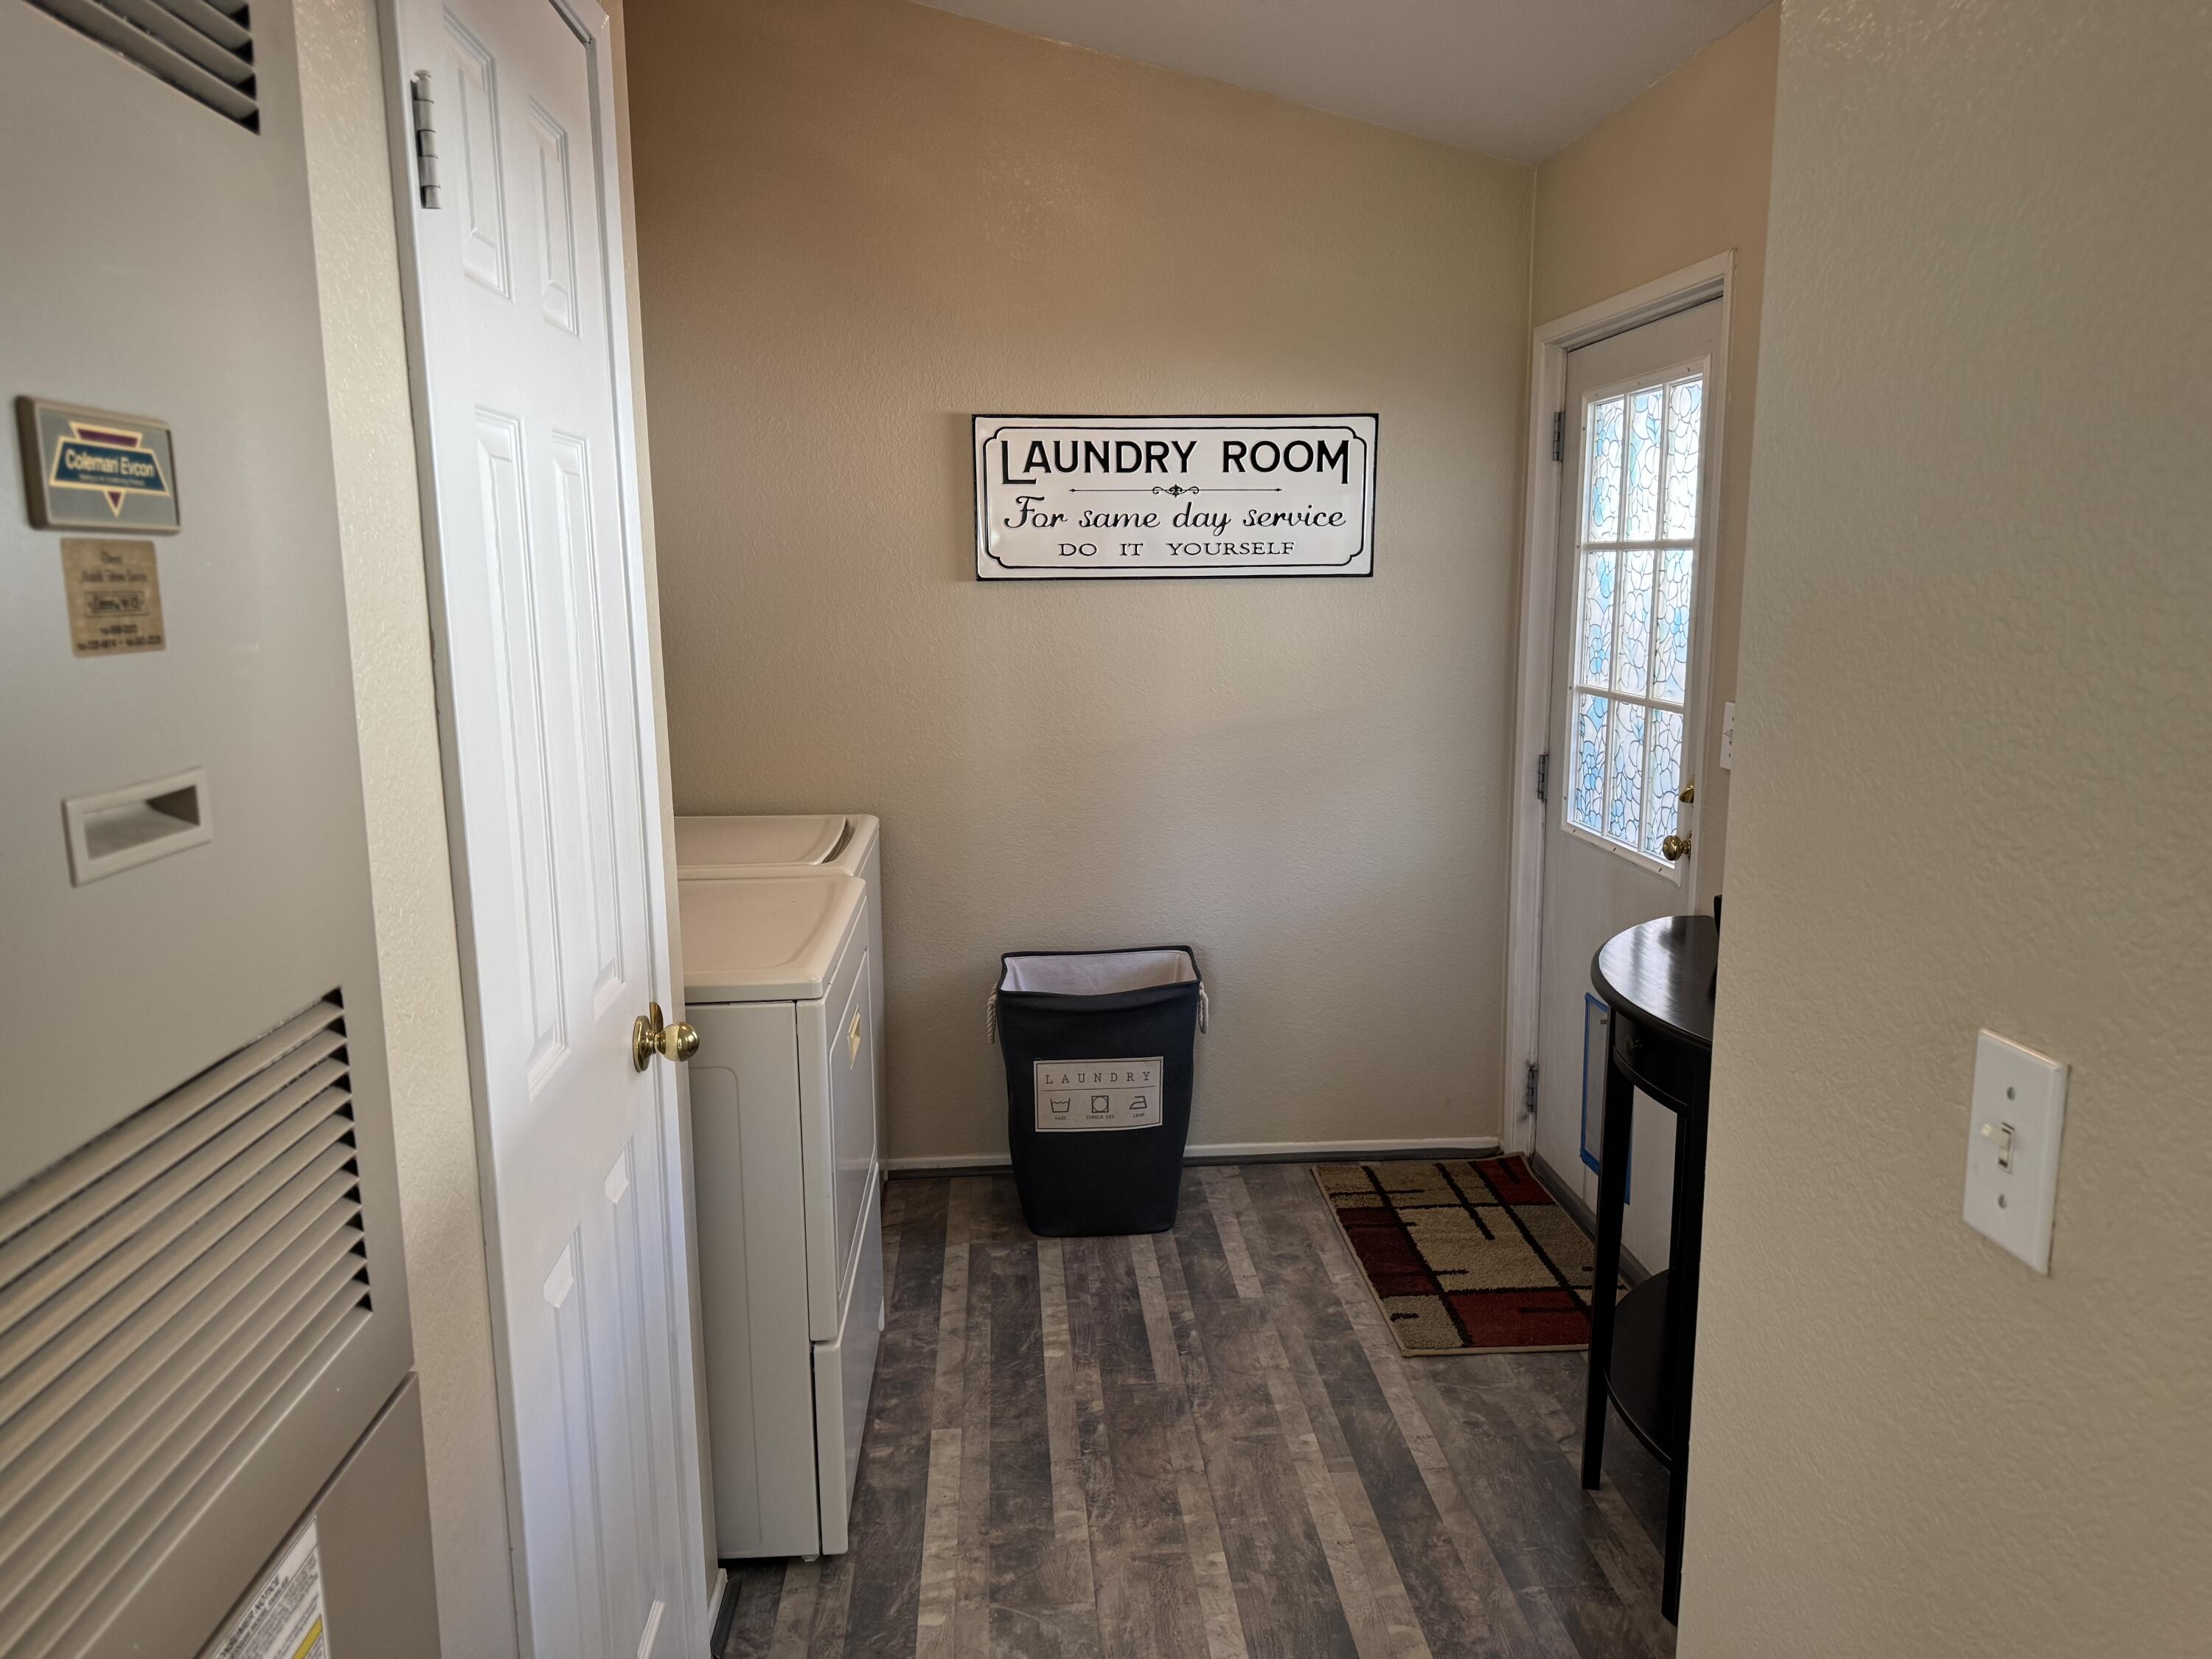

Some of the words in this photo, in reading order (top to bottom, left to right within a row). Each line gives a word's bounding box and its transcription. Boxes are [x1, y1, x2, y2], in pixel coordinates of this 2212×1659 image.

[65, 449, 119, 474] Coleman
[120, 456, 155, 477] Evcon
[1001, 440, 1198, 485] LAUNDRY
[1222, 440, 1350, 484] ROOM
[1004, 495, 1068, 529] For
[1079, 509, 1161, 529] same
[1172, 501, 1231, 537] day
[1242, 504, 1346, 529] service
[1057, 543, 1098, 557] DO
[1119, 543, 1144, 557] IT
[1169, 541, 1296, 557] YOURSELF
[1045, 1071, 1151, 1085] LAUNDRY
